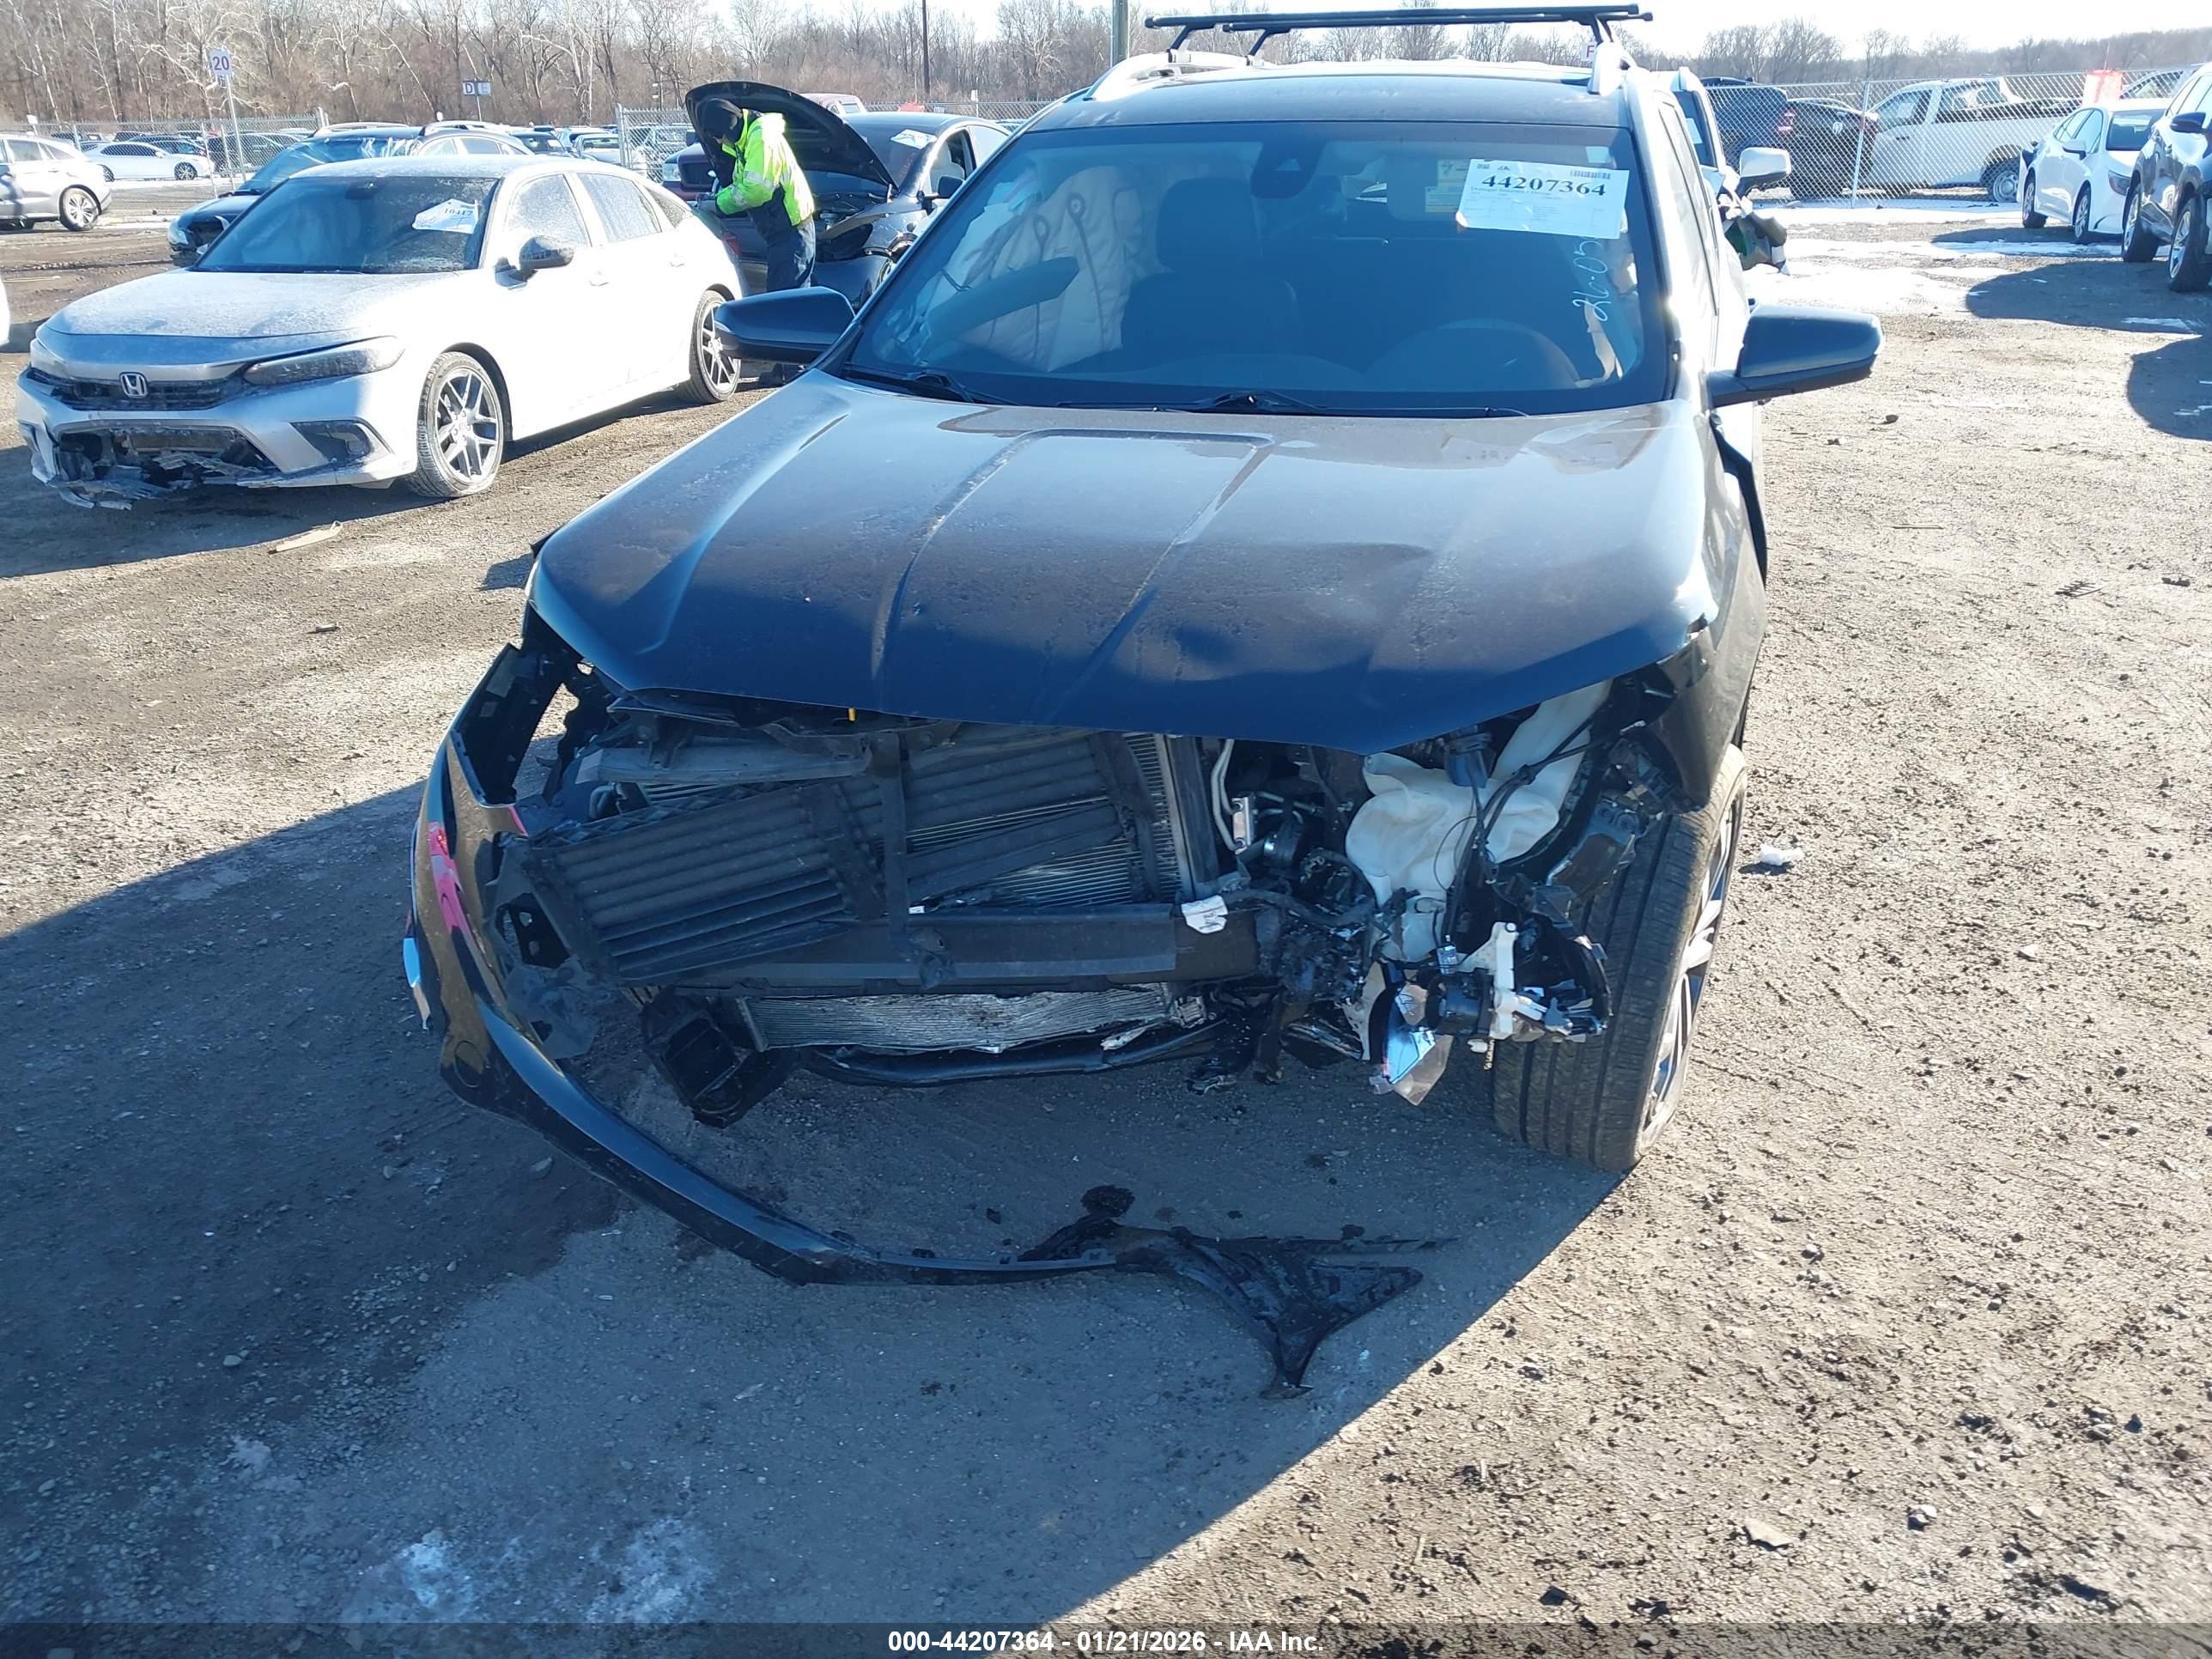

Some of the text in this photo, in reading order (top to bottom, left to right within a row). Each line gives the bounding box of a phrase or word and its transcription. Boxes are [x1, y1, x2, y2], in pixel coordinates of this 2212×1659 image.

[1586, 45, 1595, 58] F
[212, 55, 229, 70] 20
[465, 82, 473, 94] D
[1481, 174, 1607, 197] 44207364
